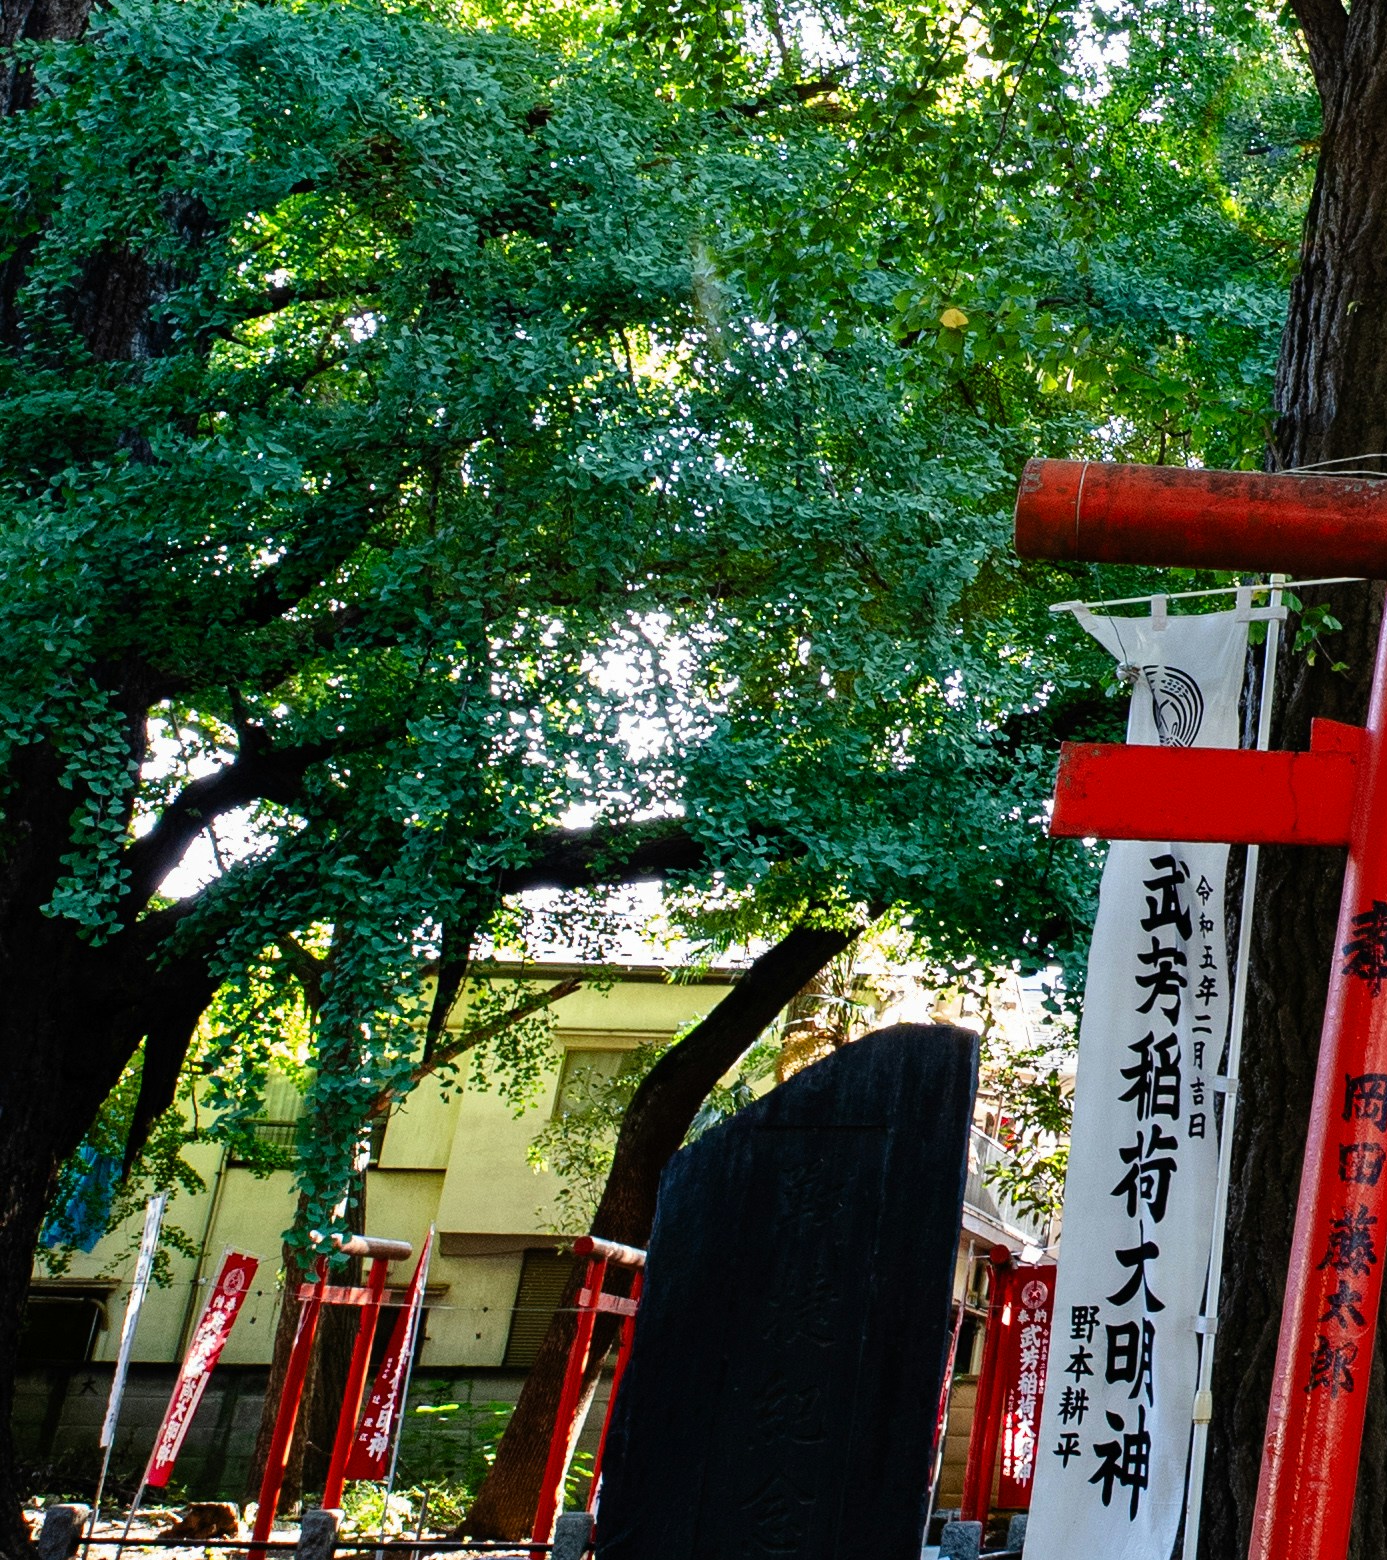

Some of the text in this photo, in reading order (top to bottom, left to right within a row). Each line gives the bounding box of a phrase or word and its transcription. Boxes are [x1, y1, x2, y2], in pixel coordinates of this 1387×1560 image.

[1188, 876, 1218, 1140] 令和五年二月吉日
[1088, 854, 1193, 1522] 武芳稲荷大明神
[1053, 1306, 1099, 1469] 野本耕平
